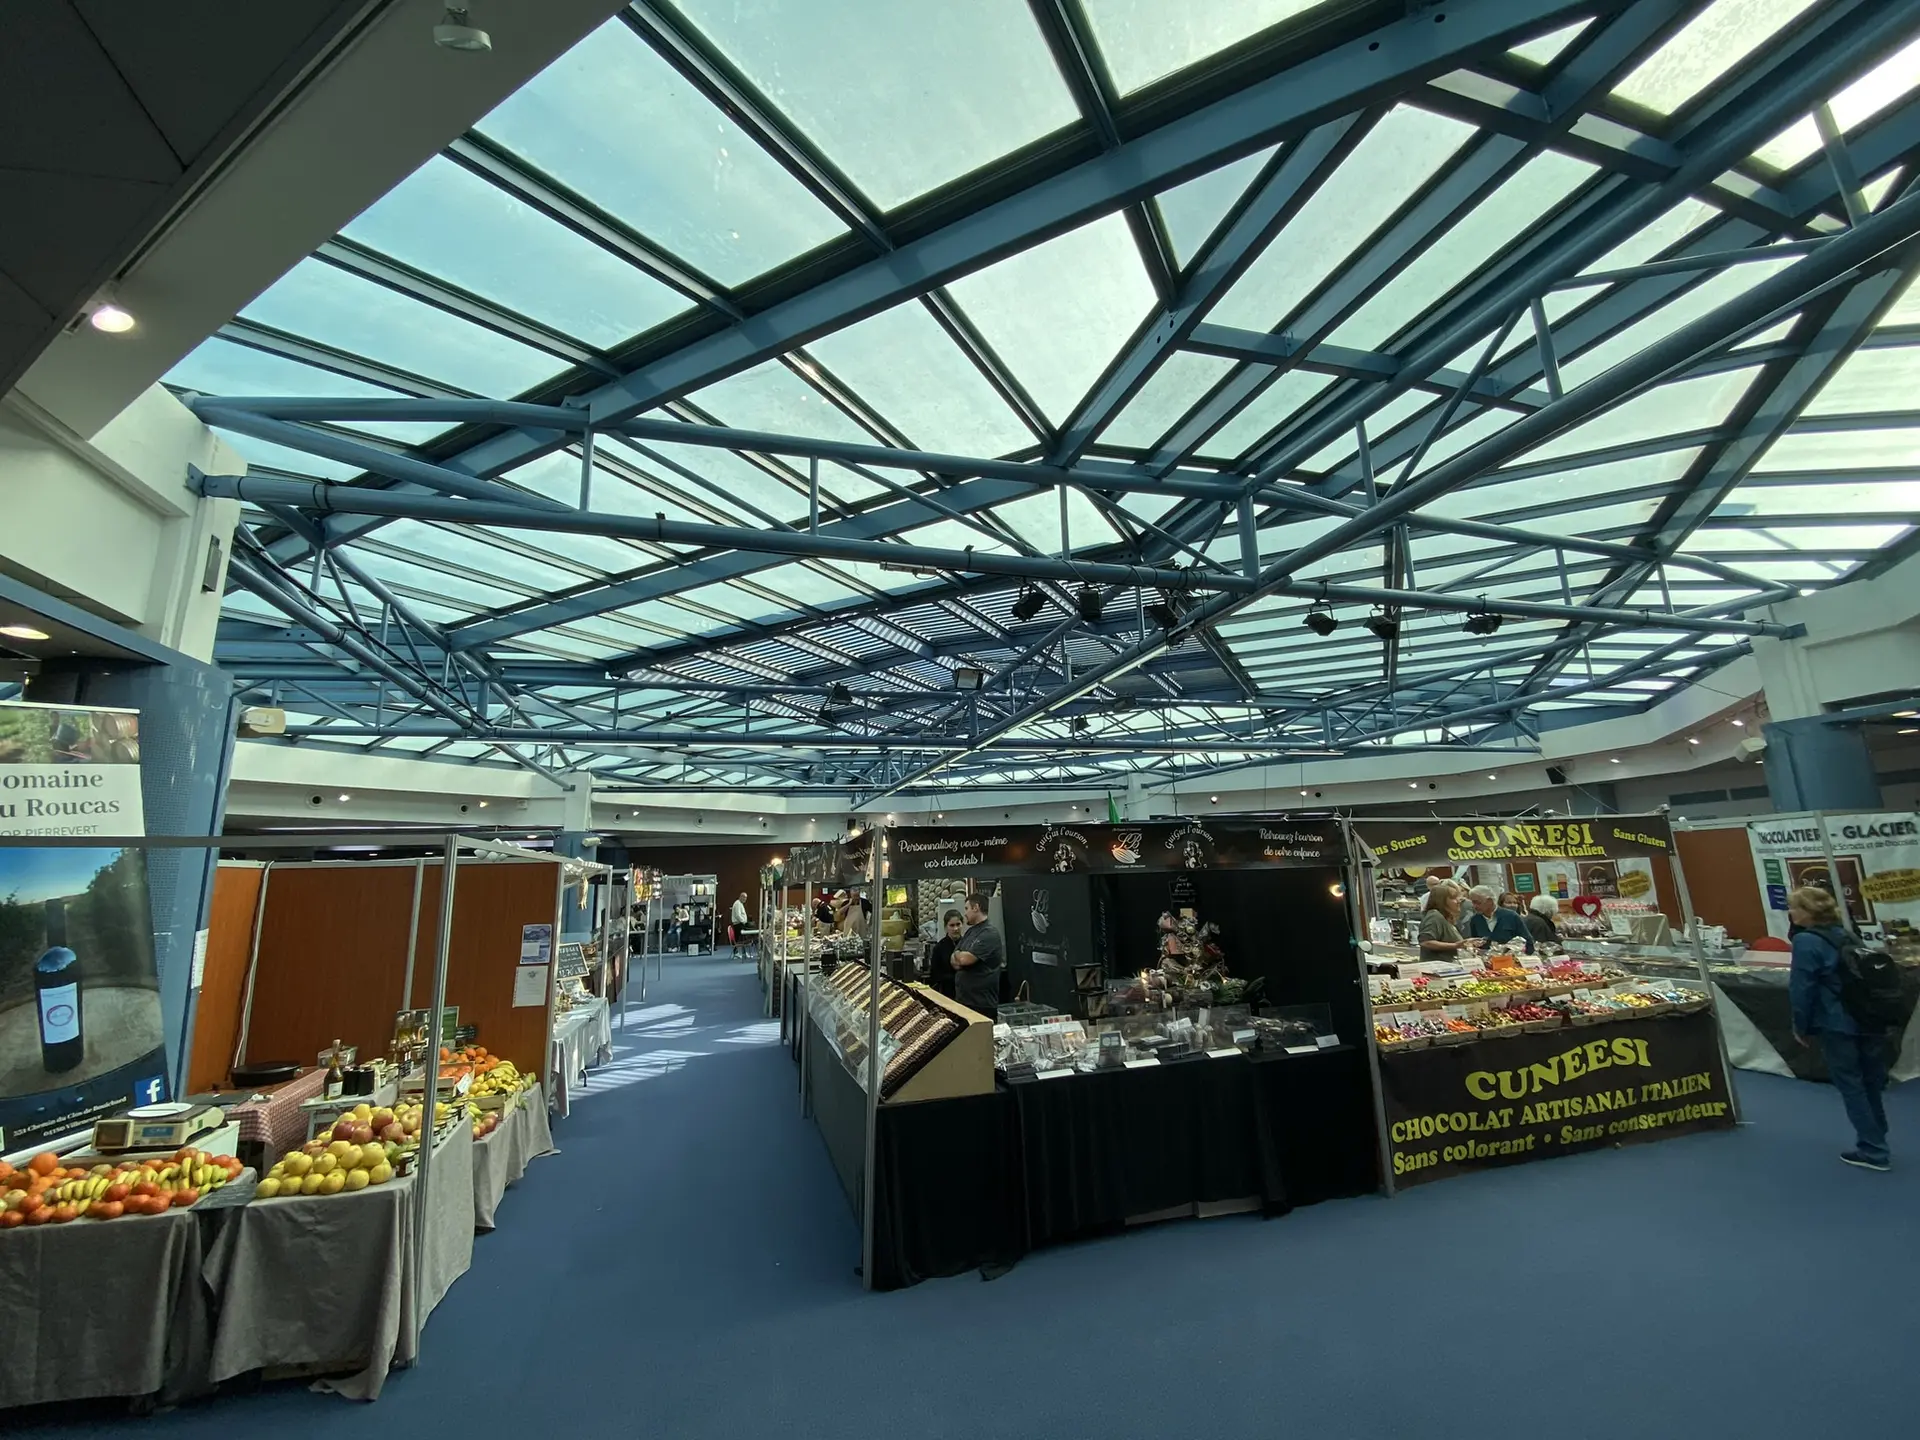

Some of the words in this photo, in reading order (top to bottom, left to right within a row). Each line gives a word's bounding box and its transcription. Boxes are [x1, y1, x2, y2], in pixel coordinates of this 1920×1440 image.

[0, 770, 103, 789] omaine
[0, 803, 16, 818] u
[27, 798, 120, 817] Roucas
[25, 825, 98, 836] PIERREVERT
[1453, 823, 1594, 848] CUNEESI
[1613, 828, 1636, 842] Sans
[1637, 833, 1667, 848] Gluten
[1843, 821, 1918, 839] GLACIER
[898, 839, 959, 852] Personnalisez
[960, 836, 1008, 848] vous-même
[1264, 845, 1274, 856] de
[1294, 847, 1321, 860] enfance
[1371, 844, 1389, 856] ans
[1390, 835, 1427, 851] Sucres
[1447, 846, 1512, 861] Chocolat
[1515, 846, 1566, 857] Artisanal
[1568, 845, 1606, 857] Italien
[924, 859, 940, 868] vos
[941, 853, 978, 867] chocolats
[1465, 1037, 1651, 1100] CUNEESI
[1391, 1108, 1514, 1143] CHOCOLAT
[1520, 1088, 1637, 1125] ARTISANAL
[1641, 1071, 1711, 1103] ITALIEN
[1393, 1149, 1438, 1175] Sans
[1444, 1132, 1535, 1162] colorant
[1561, 1124, 1604, 1144] Sans
[1609, 1101, 1727, 1134] conservateur
